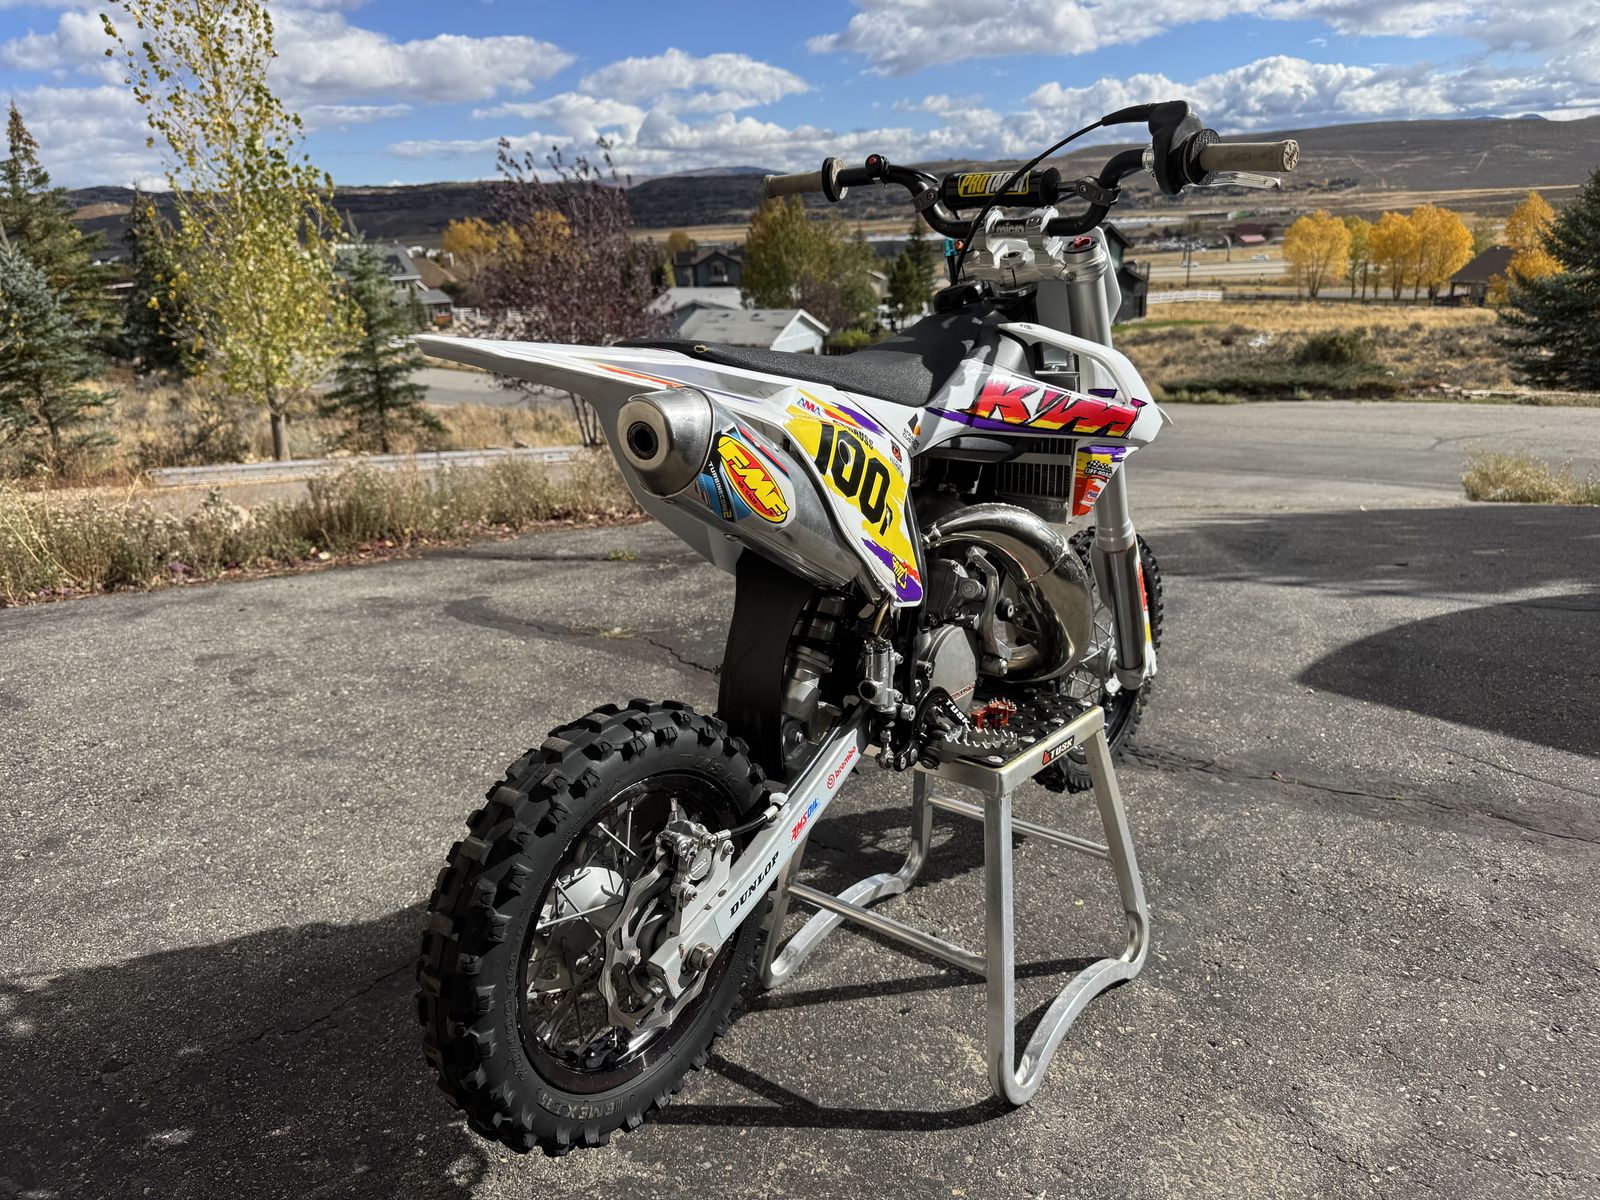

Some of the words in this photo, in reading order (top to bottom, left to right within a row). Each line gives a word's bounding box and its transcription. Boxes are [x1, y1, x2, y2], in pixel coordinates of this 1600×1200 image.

[995, 222, 1025, 233] micro
[797, 398, 822, 417] AMA
[954, 378, 1135, 438] KTM
[717, 440, 790, 517] FMF
[947, 698, 971, 729] TUSK
[834, 746, 859, 779] brembo
[1049, 737, 1075, 760] TUSK
[790, 798, 820, 842] AMSOIL
[729, 850, 780, 919] DUNLOP
